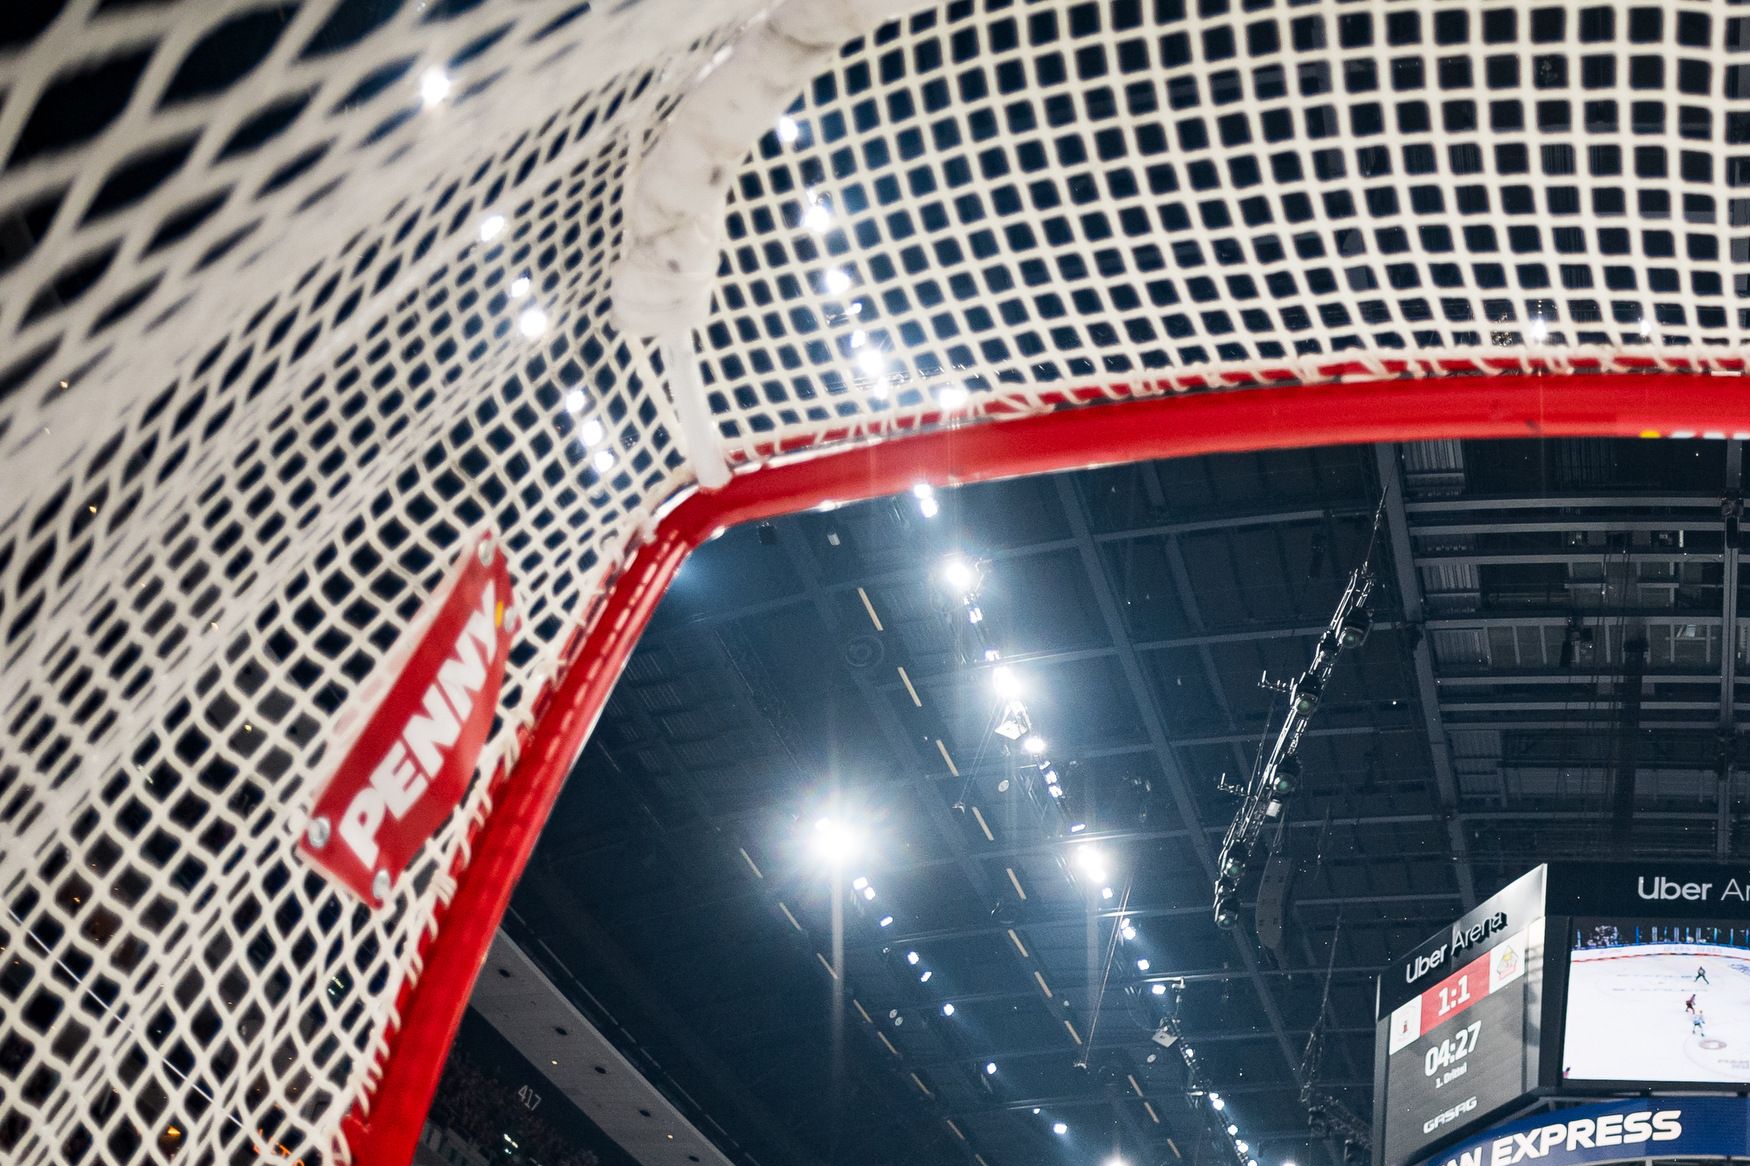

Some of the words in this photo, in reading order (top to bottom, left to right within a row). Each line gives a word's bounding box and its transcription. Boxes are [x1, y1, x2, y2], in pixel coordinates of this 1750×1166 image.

[1637, 876, 1713, 901] Uber
[1405, 944, 1447, 984] Uber
[1450, 910, 1508, 956] Arena
[1437, 974, 1471, 1017] 1:1
[1424, 1020, 1482, 1077] 04:27
[518, 1085, 542, 1112] 417
[1423, 1095, 1478, 1134] GASAG
